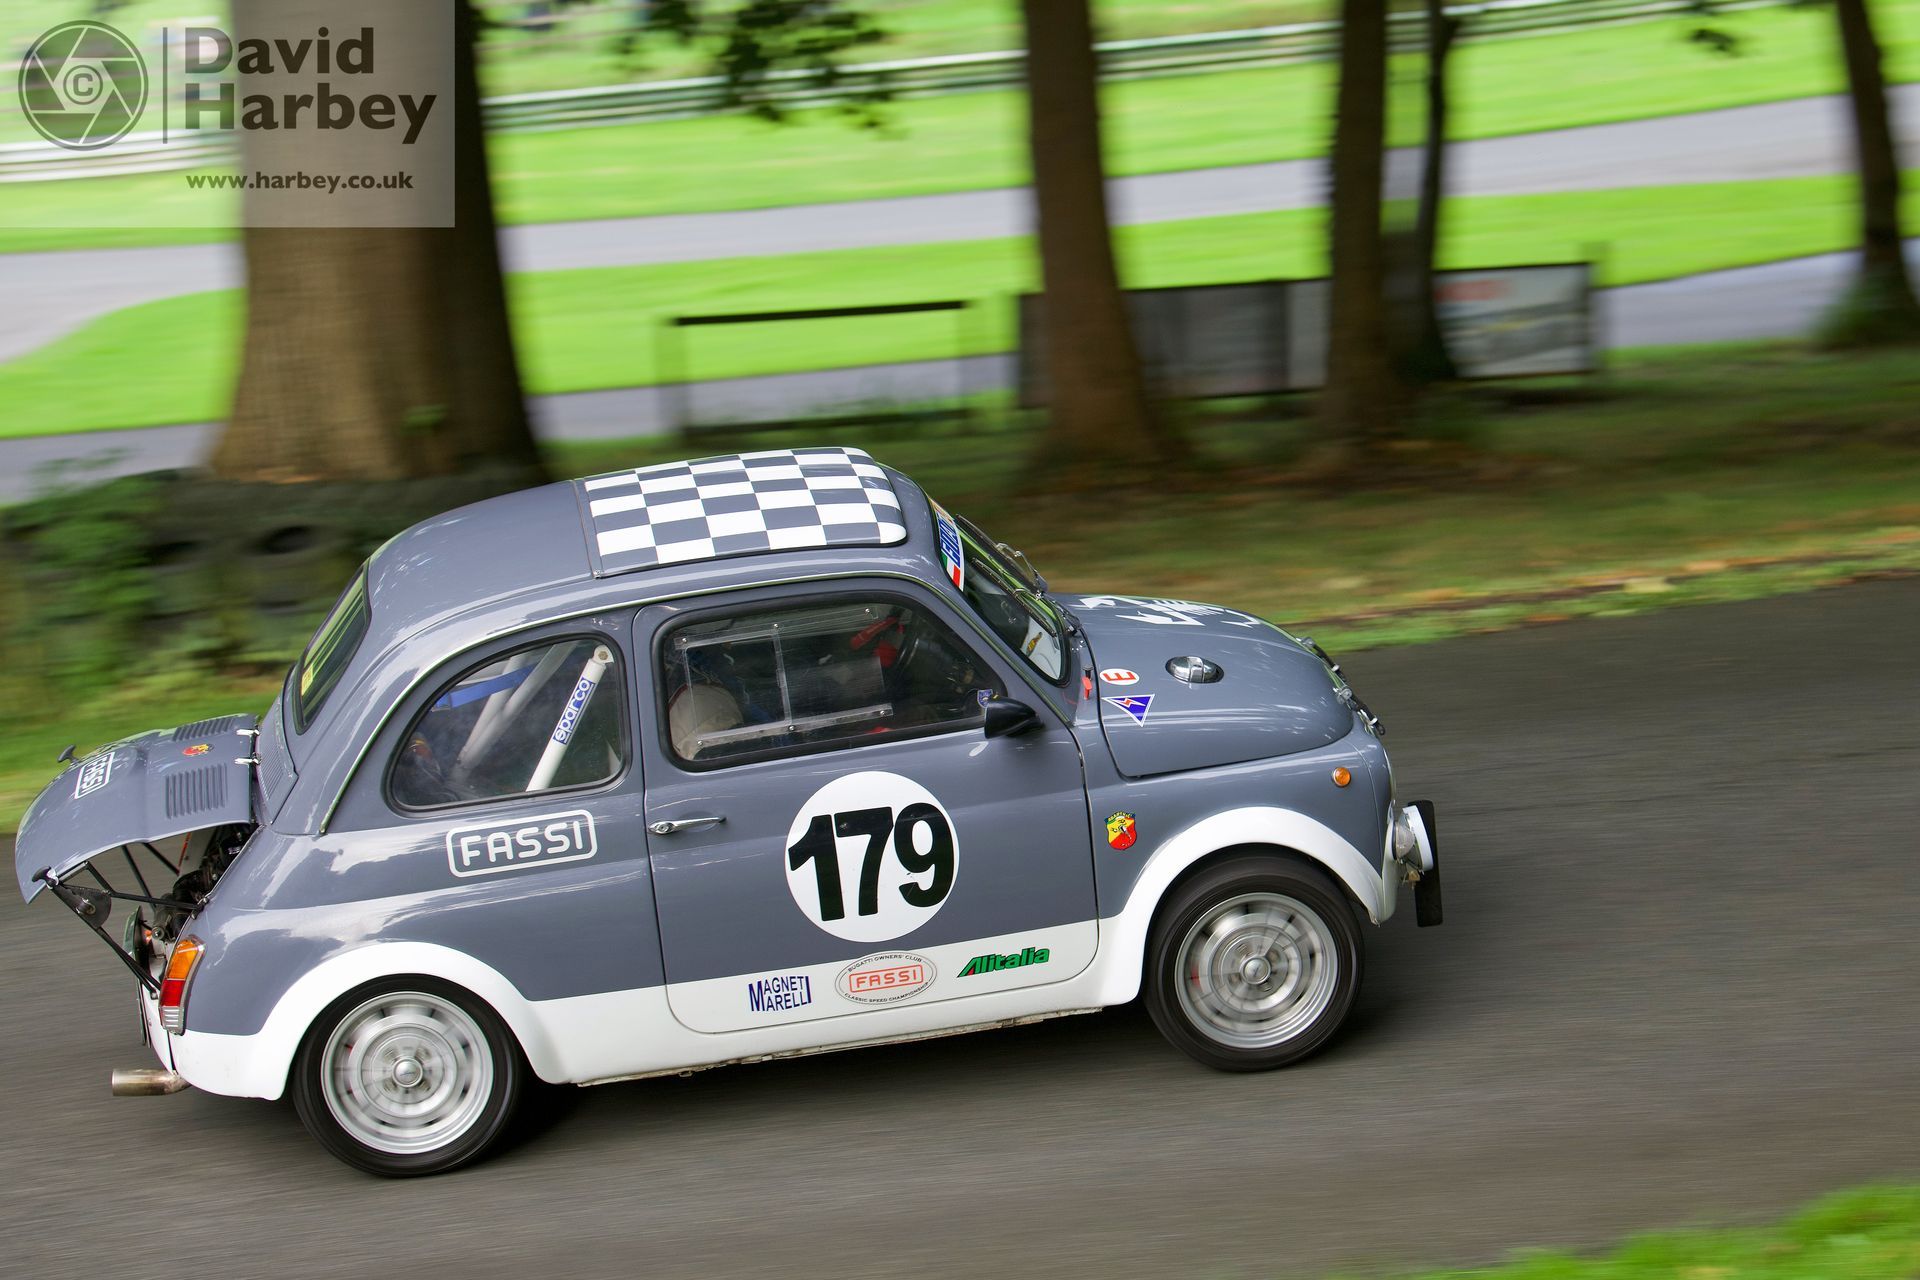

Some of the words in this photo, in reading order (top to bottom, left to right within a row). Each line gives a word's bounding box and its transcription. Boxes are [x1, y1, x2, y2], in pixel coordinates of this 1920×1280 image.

[1103, 671, 1137, 682] E
[555, 679, 591, 742] sparco
[460, 820, 583, 867] FASSI
[788, 802, 954, 922] 179
[848, 958, 874, 972] BUGATTI
[905, 955, 922, 963] CLUB
[957, 947, 1050, 978] Alitalia
[748, 976, 812, 1000] MAGNETI
[856, 969, 917, 988] FASSI
[748, 988, 812, 1011] MARELLI
[844, 992, 868, 1003] CLASSIC
[888, 981, 929, 1001] CHAMPIONSHIP
